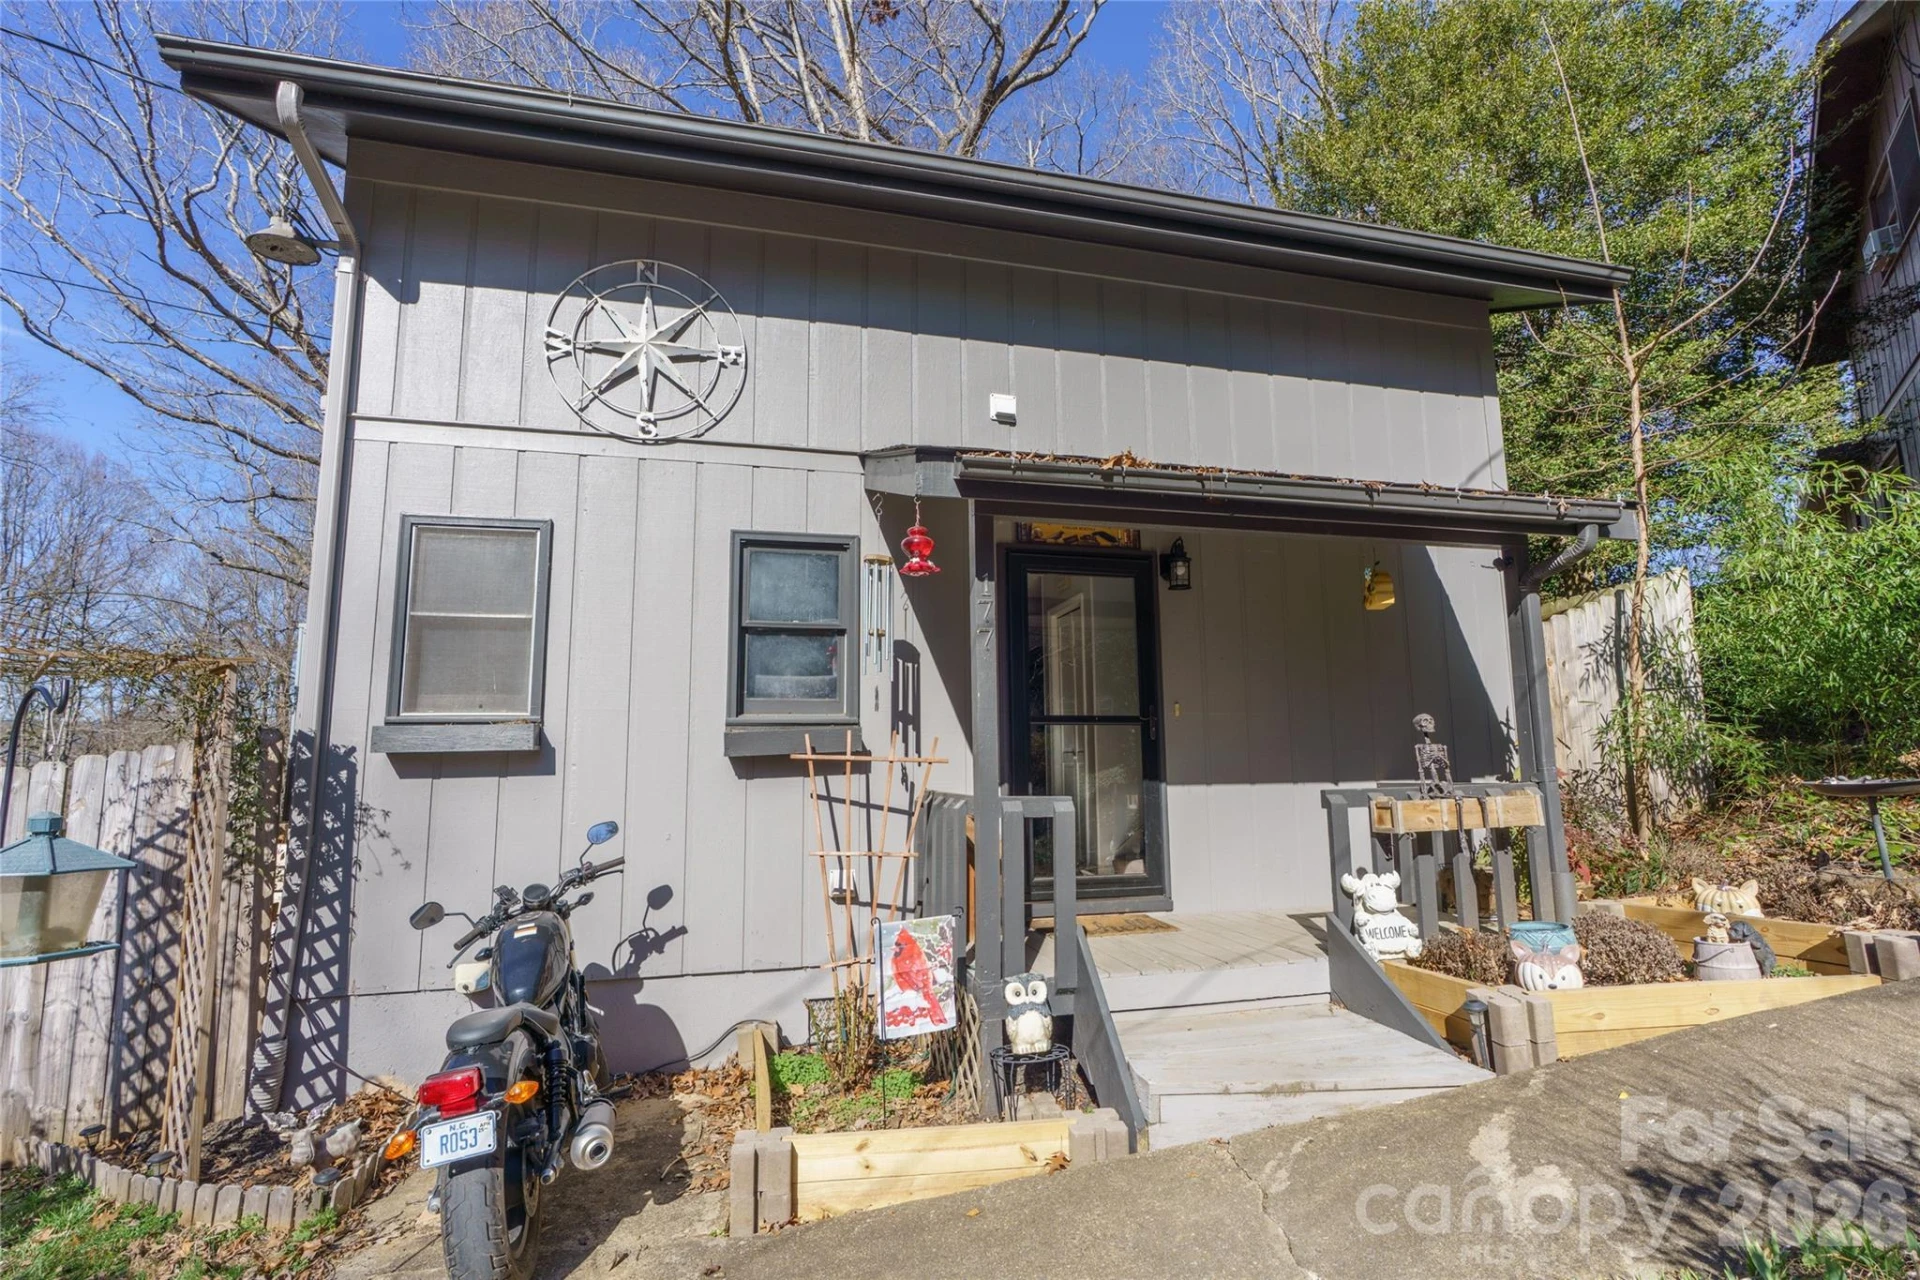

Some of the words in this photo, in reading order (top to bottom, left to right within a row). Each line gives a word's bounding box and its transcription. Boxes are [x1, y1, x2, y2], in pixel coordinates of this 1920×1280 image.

[635, 259, 659, 284] N
[544, 326, 573, 359] W
[716, 345, 744, 364] E
[636, 412, 658, 439] S
[976, 572, 995, 653] 177
[1364, 925, 1407, 940] WELCOME
[449, 1122, 469, 1131] N.C.
